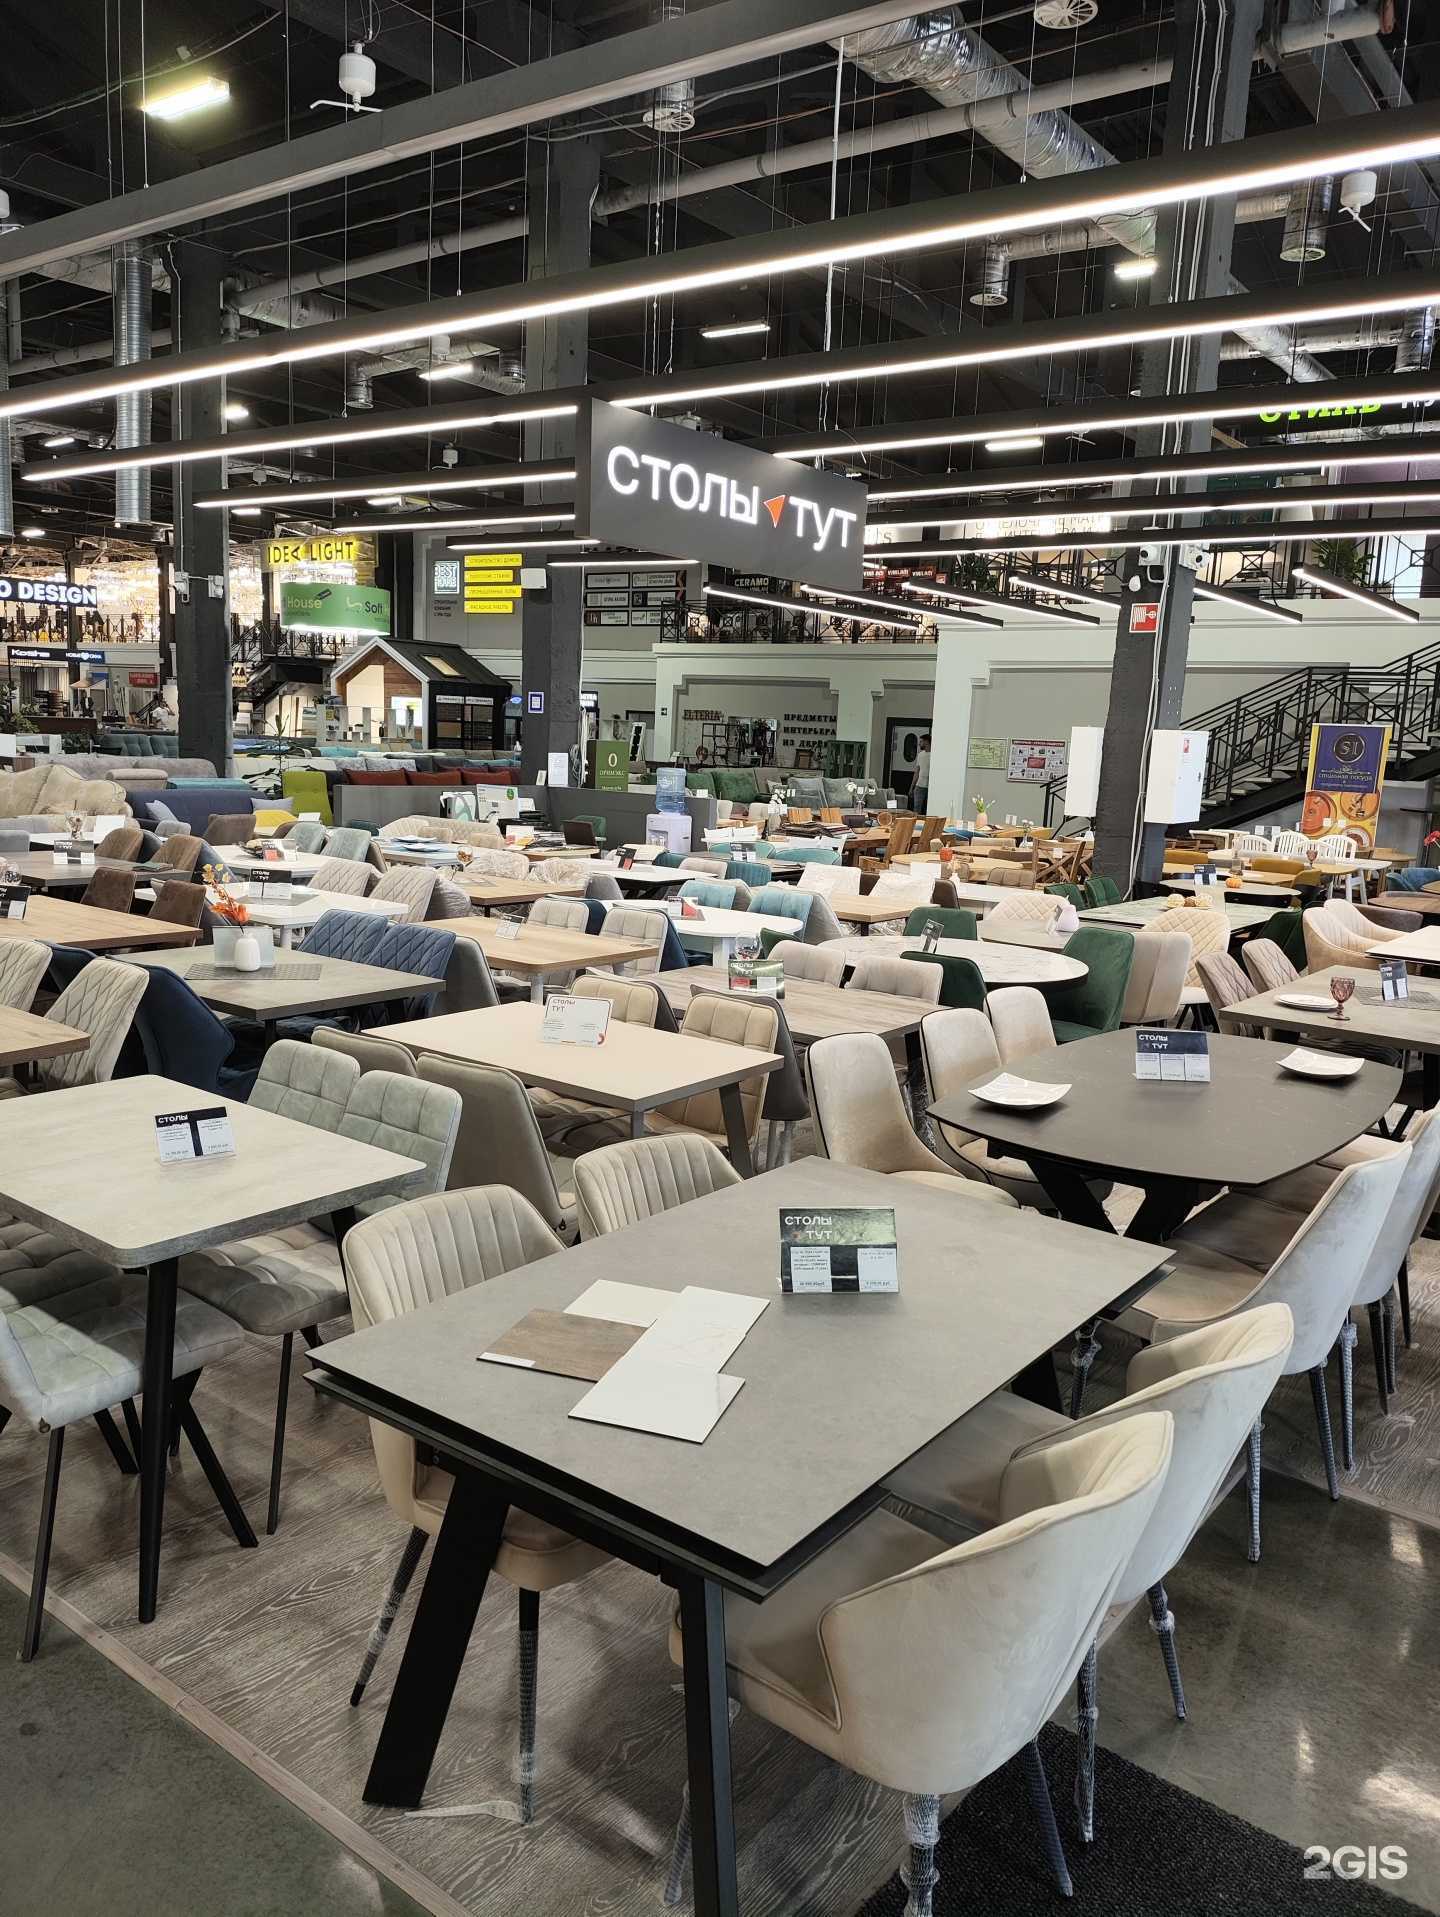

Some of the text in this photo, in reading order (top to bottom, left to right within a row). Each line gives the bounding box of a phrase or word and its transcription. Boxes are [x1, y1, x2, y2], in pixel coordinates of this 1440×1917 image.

[607, 445, 857, 551] СТОЛЫ ТУТ
[268, 542, 353, 563] IDEA LIGHT
[734, 577, 769, 587] CERAMO
[18, 581, 97, 605] DESIGN
[287, 596, 322, 609] House
[784, 713, 837, 722] ПРЕДМЕТЫ
[783, 727, 837, 736] ИНТЕРЬЕРА
[158, 1114, 188, 1124] СТОЛЫ
[784, 1216, 833, 1225] СТОЛЫ
[806, 1230, 832, 1239] ТУТ
